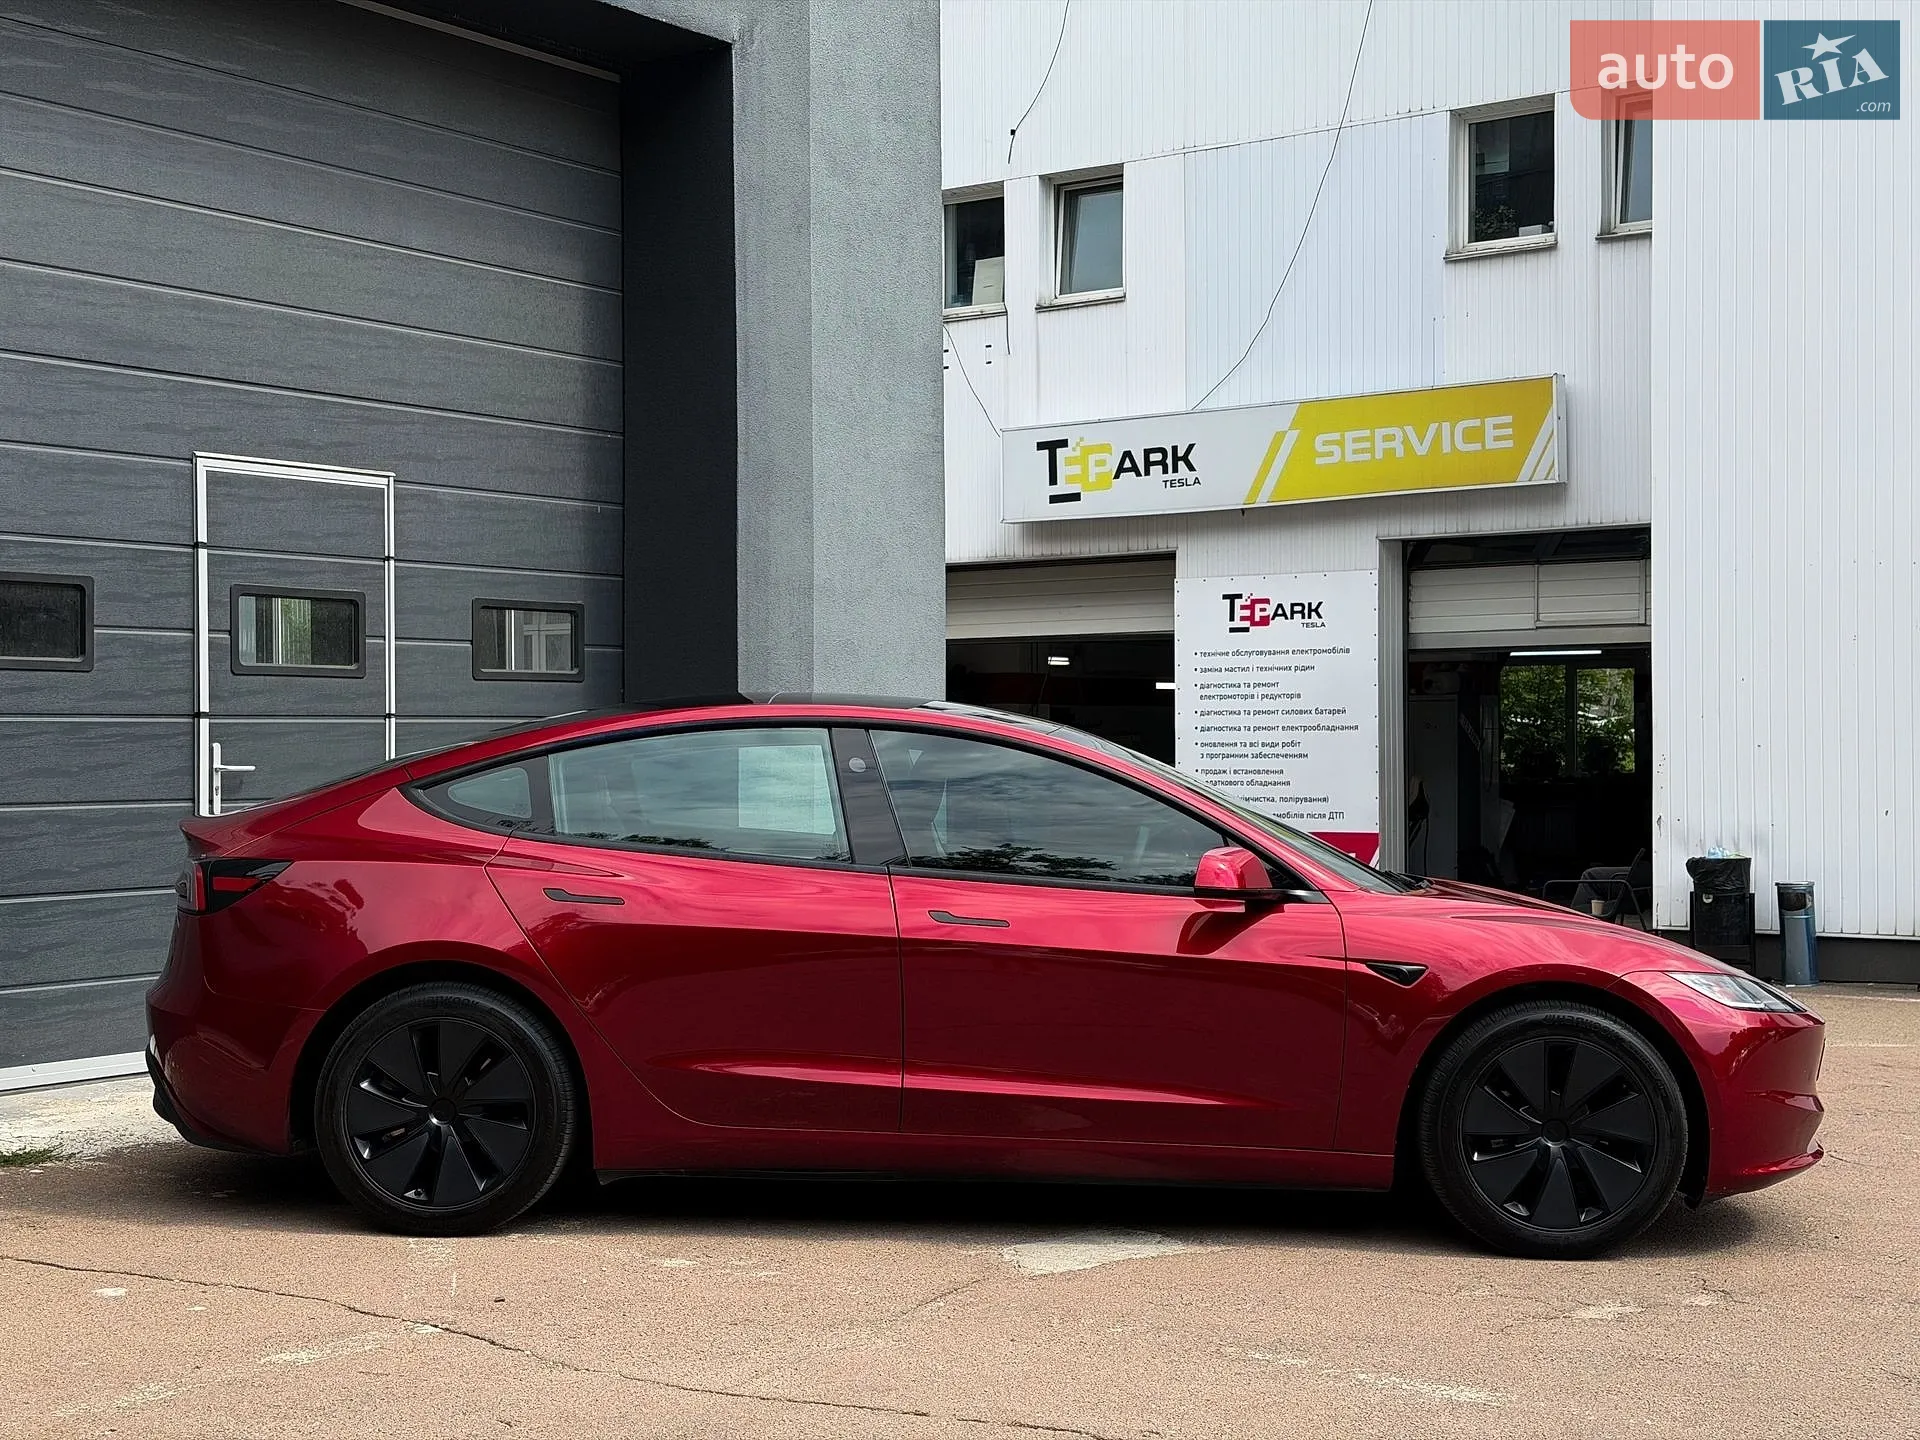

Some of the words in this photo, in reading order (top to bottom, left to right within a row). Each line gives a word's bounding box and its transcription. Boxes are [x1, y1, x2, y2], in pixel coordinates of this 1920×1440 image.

[1315, 415, 1514, 465] SERVICE
[1036, 438, 1197, 492] TEPARK
[1162, 477, 1201, 489] TESLA
[1222, 593, 1323, 626] TEPARK
[1232, 649, 1289, 657] обслуговування
[1292, 647, 1350, 656] електромобілів
[1315, 707, 1346, 716] батарей
[1282, 724, 1358, 732] електрообладнання
[1282, 740, 1301, 748] робіт
[1246, 779, 1290, 787] обладнання
[1237, 795, 1278, 804] імчистка,
[1280, 796, 1329, 804] полірування)
[1272, 812, 1305, 820] мобілів
[1328, 812, 1344, 820] ДТП
